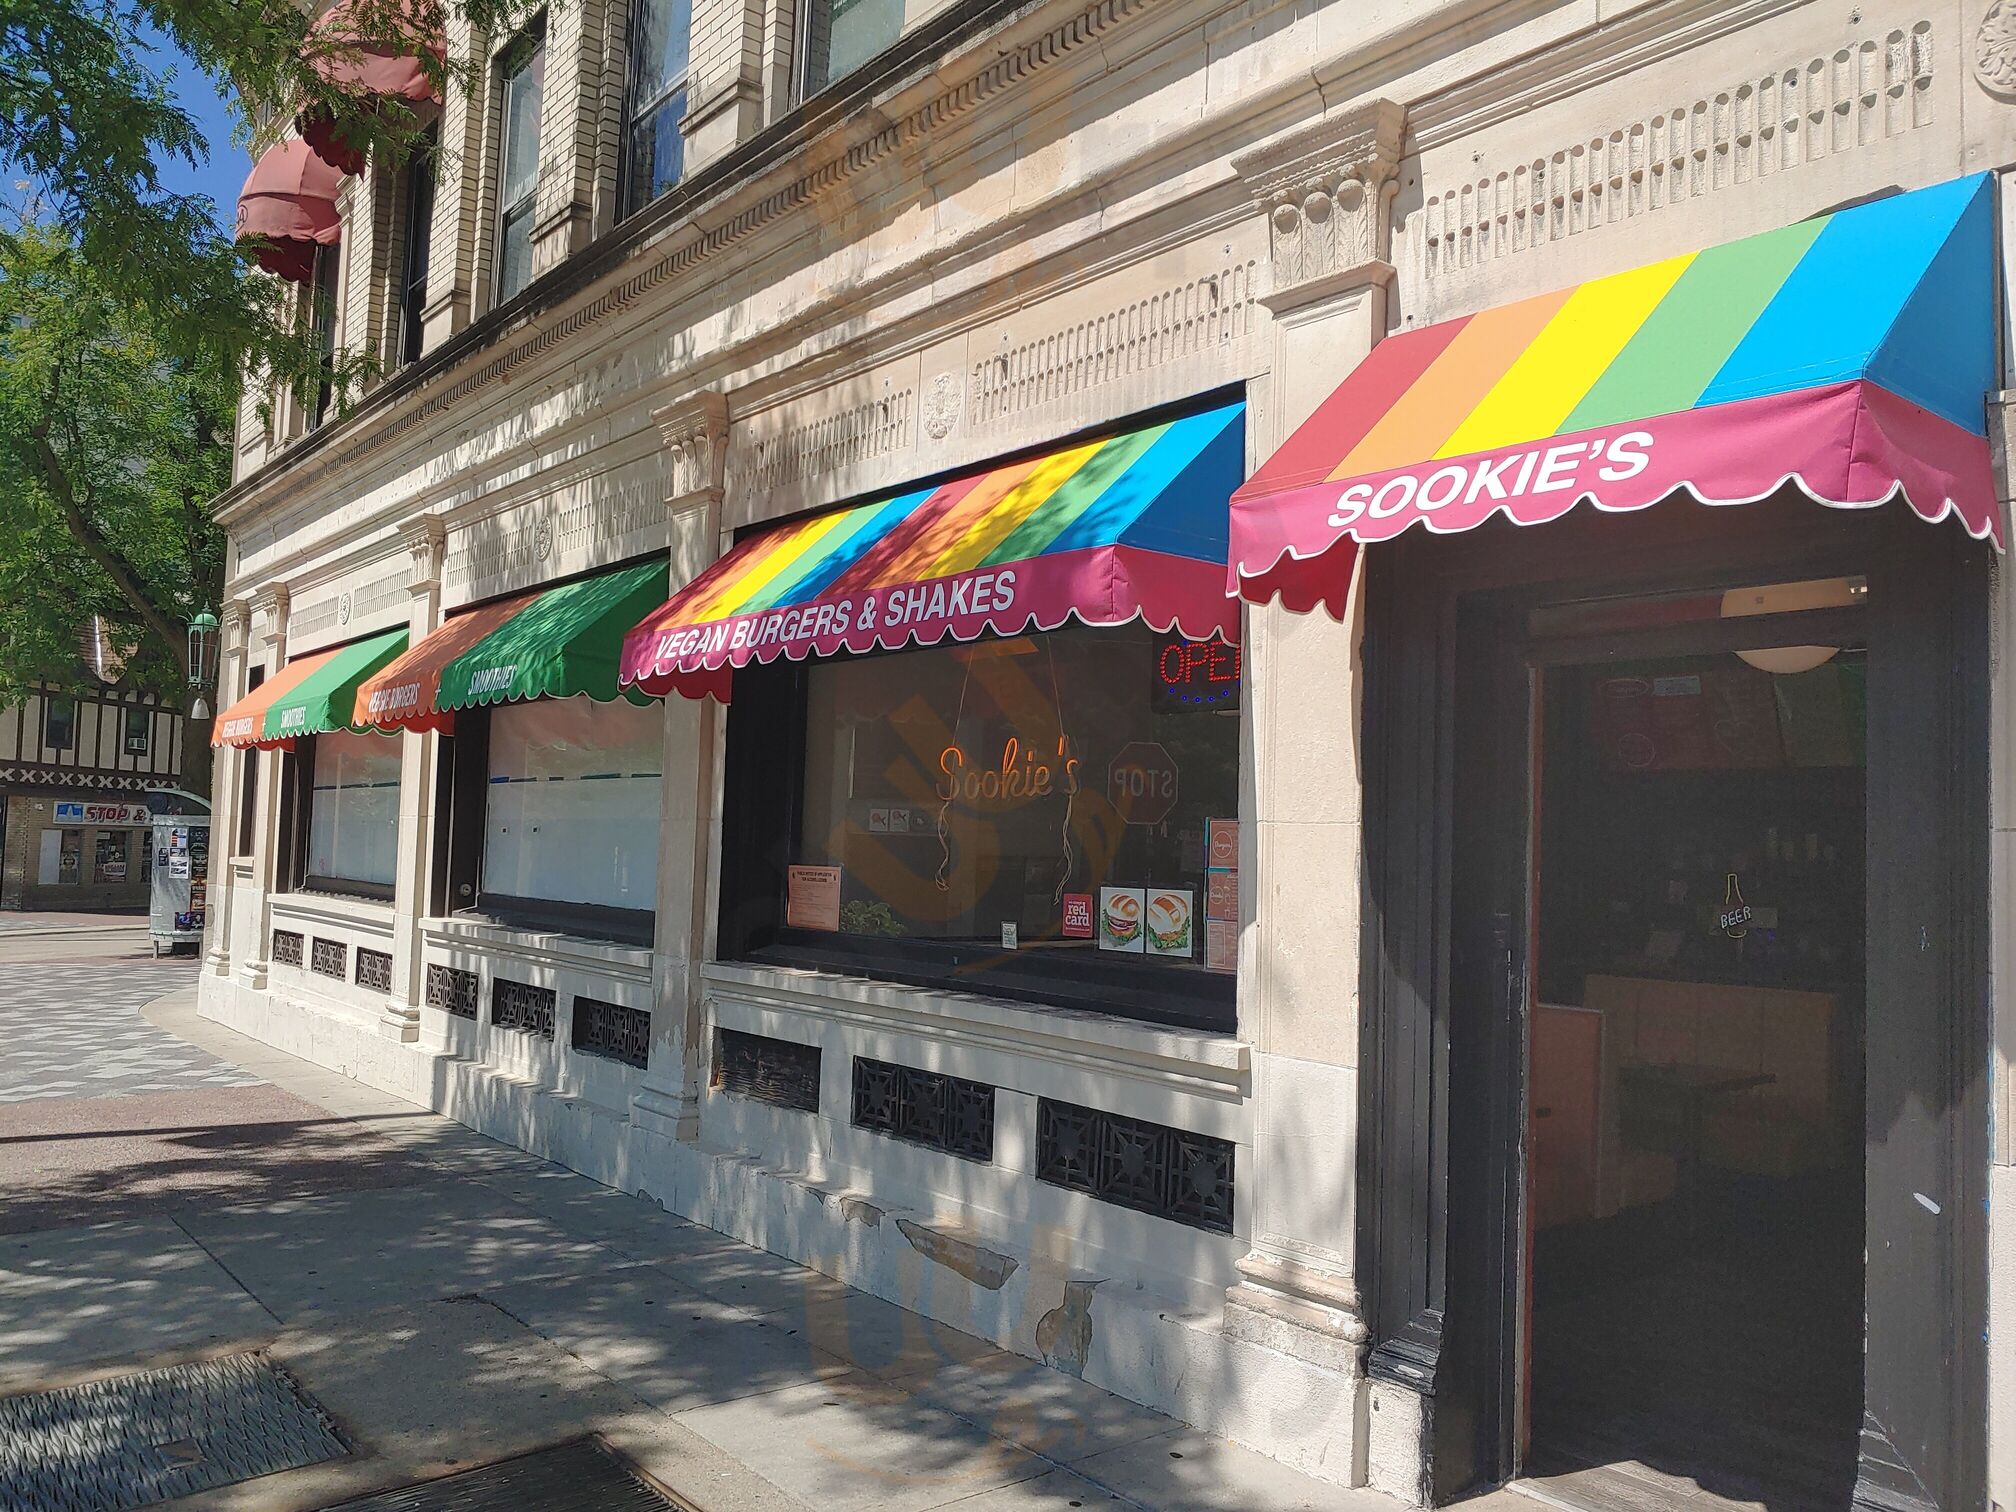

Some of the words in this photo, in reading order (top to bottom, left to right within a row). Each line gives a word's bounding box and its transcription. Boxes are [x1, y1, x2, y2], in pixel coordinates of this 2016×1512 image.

[1327, 431, 1654, 528] SOOKIE'S
[655, 622, 727, 660] VEGAN
[730, 600, 852, 650] BURGERS
[857, 596, 877, 631] &
[884, 570, 1016, 627] SHAKES
[1159, 641, 1240, 683] OPE
[467, 664, 518, 696] SMOOTHIES
[936, 735, 1079, 801] Sookie's
[86, 806, 130, 822] STOP
[133, 809, 145, 822] &
[1065, 912, 1089, 926] card
[1067, 901, 1087, 916] red
[1720, 906, 1751, 929] BEER
